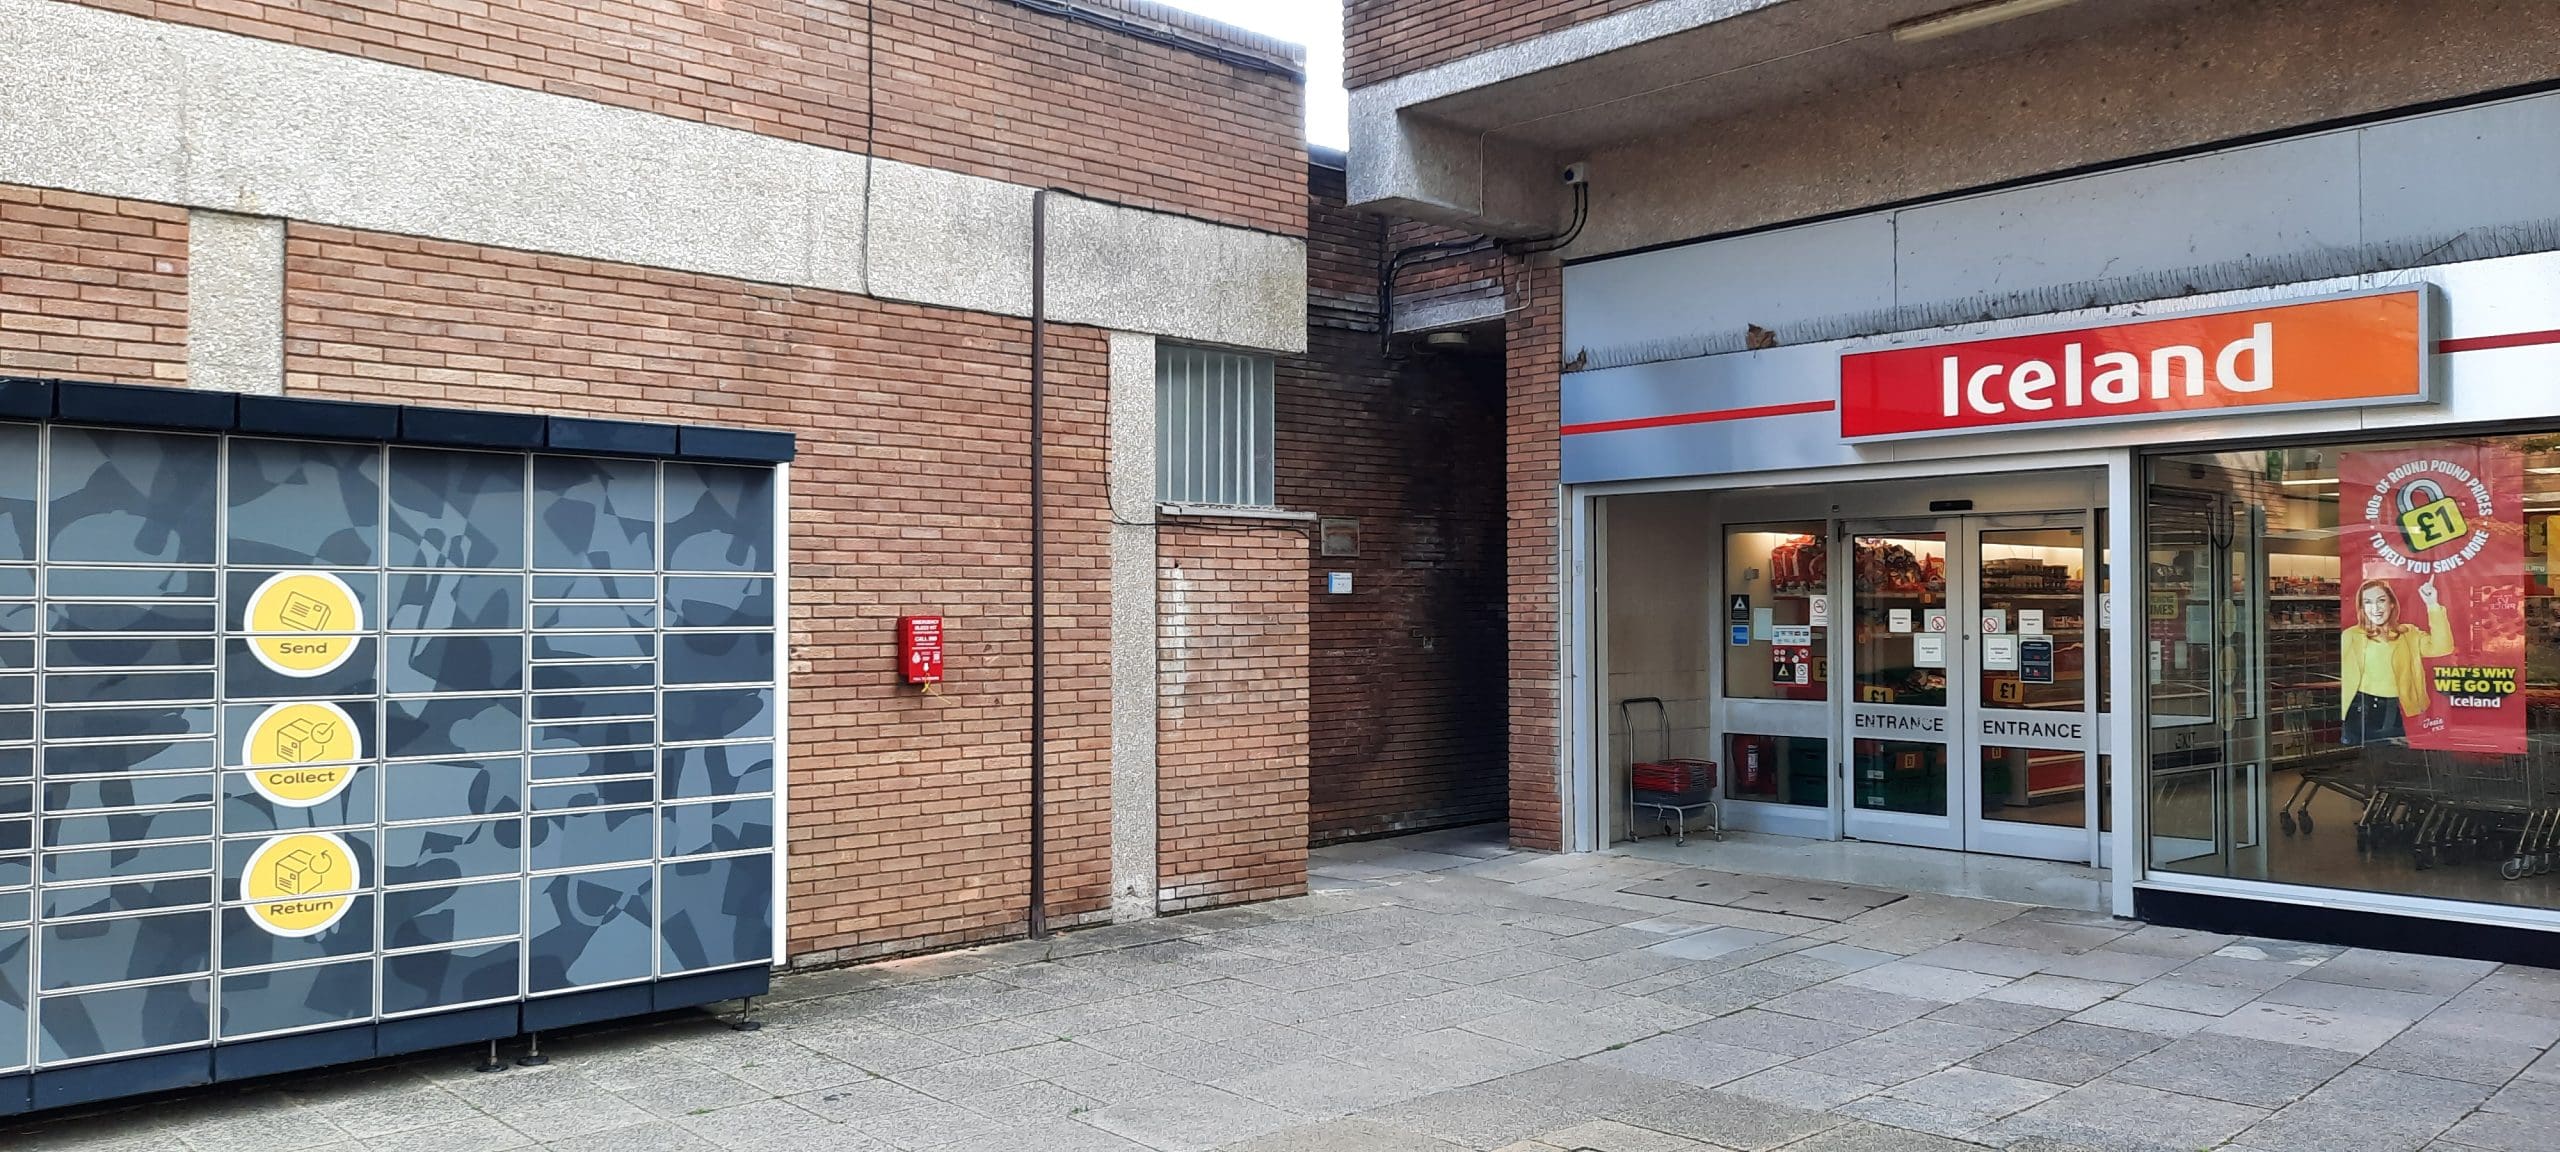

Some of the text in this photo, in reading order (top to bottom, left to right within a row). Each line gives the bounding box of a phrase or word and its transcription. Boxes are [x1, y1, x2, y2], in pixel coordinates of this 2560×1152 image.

[1943, 322, 2273, 417] Iceland
[2376, 479, 2390, 494] OF
[2387, 460, 2428, 483] ROUND
[2430, 459, 2471, 482] POUND
[2466, 477, 2493, 516] PRICES
[2416, 505, 2455, 542] £1
[2370, 529, 2490, 574] TO HELP YOU SAVE MORE
[280, 641, 327, 654] Send
[2433, 667, 2516, 679] THAT'S WHY
[2000, 682, 2016, 699] £1
[2434, 679, 2516, 694] WE GO TO
[2450, 695, 2501, 708] Iceland
[1855, 713, 1944, 732] ENTRANCE
[1983, 720, 2082, 739] ENTRANCE
[269, 771, 335, 786] Collect
[270, 899, 333, 917] Return
